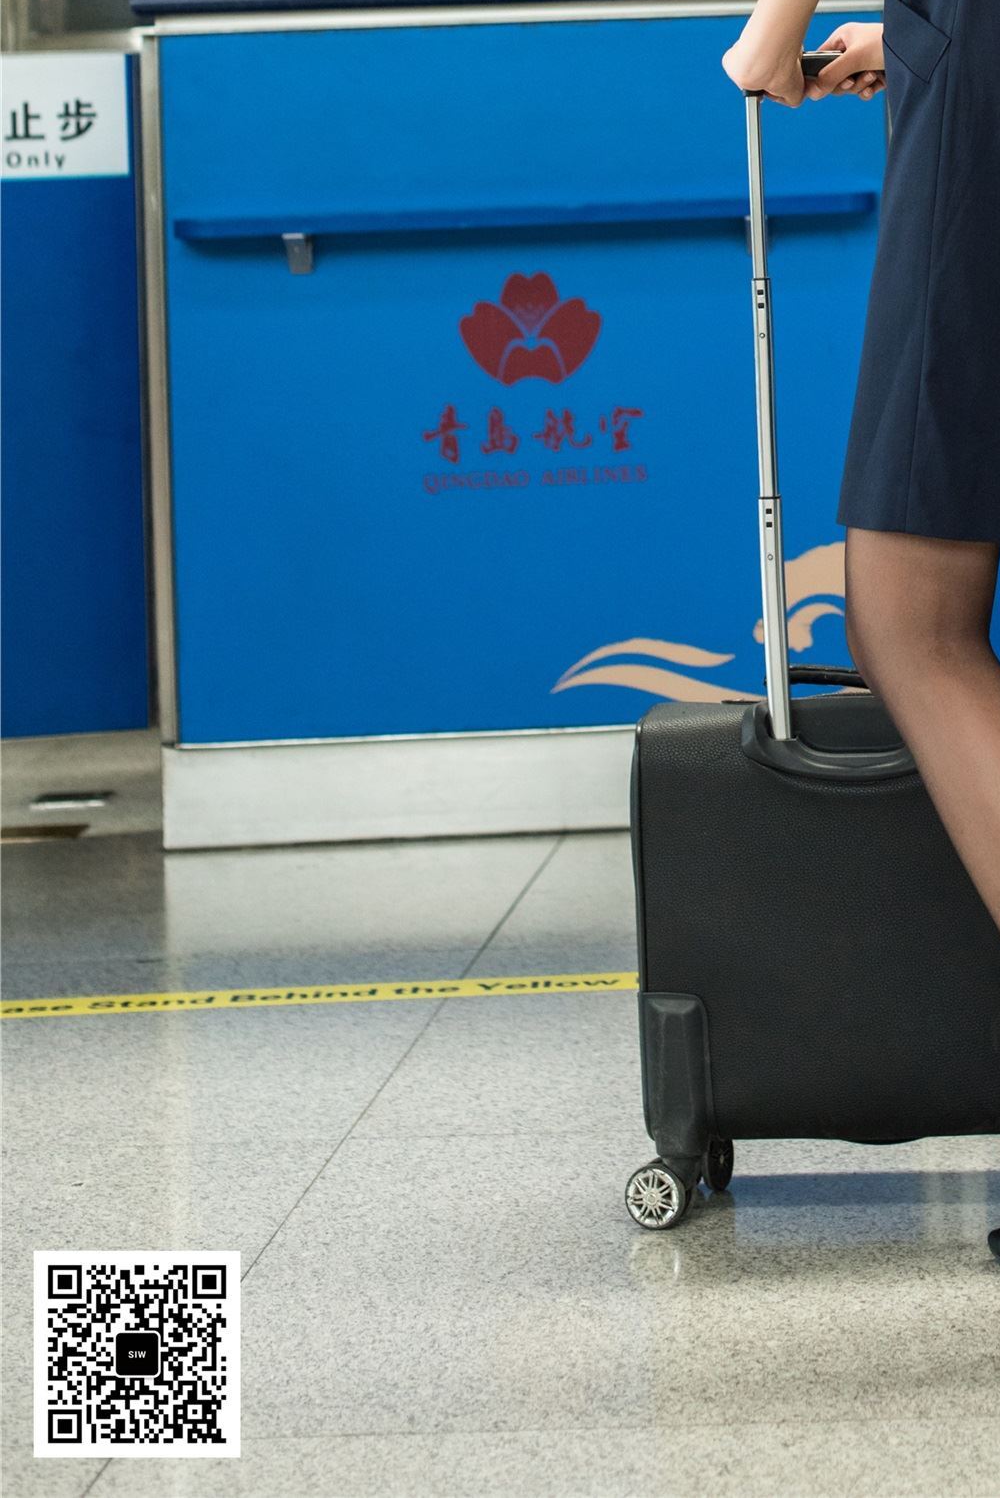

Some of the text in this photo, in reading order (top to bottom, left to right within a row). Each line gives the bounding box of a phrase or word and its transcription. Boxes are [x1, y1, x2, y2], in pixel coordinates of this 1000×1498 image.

[4, 97, 97, 141] 止步
[6, 150, 67, 171] Only
[423, 405, 645, 464] 青岛航空
[423, 465, 648, 496] QINGDAO AIRLINES
[87, 995, 216, 1011] Stand
[229, 988, 378, 1003] Behind
[393, 985, 461, 997] the
[477, 978, 621, 992] Yellow
